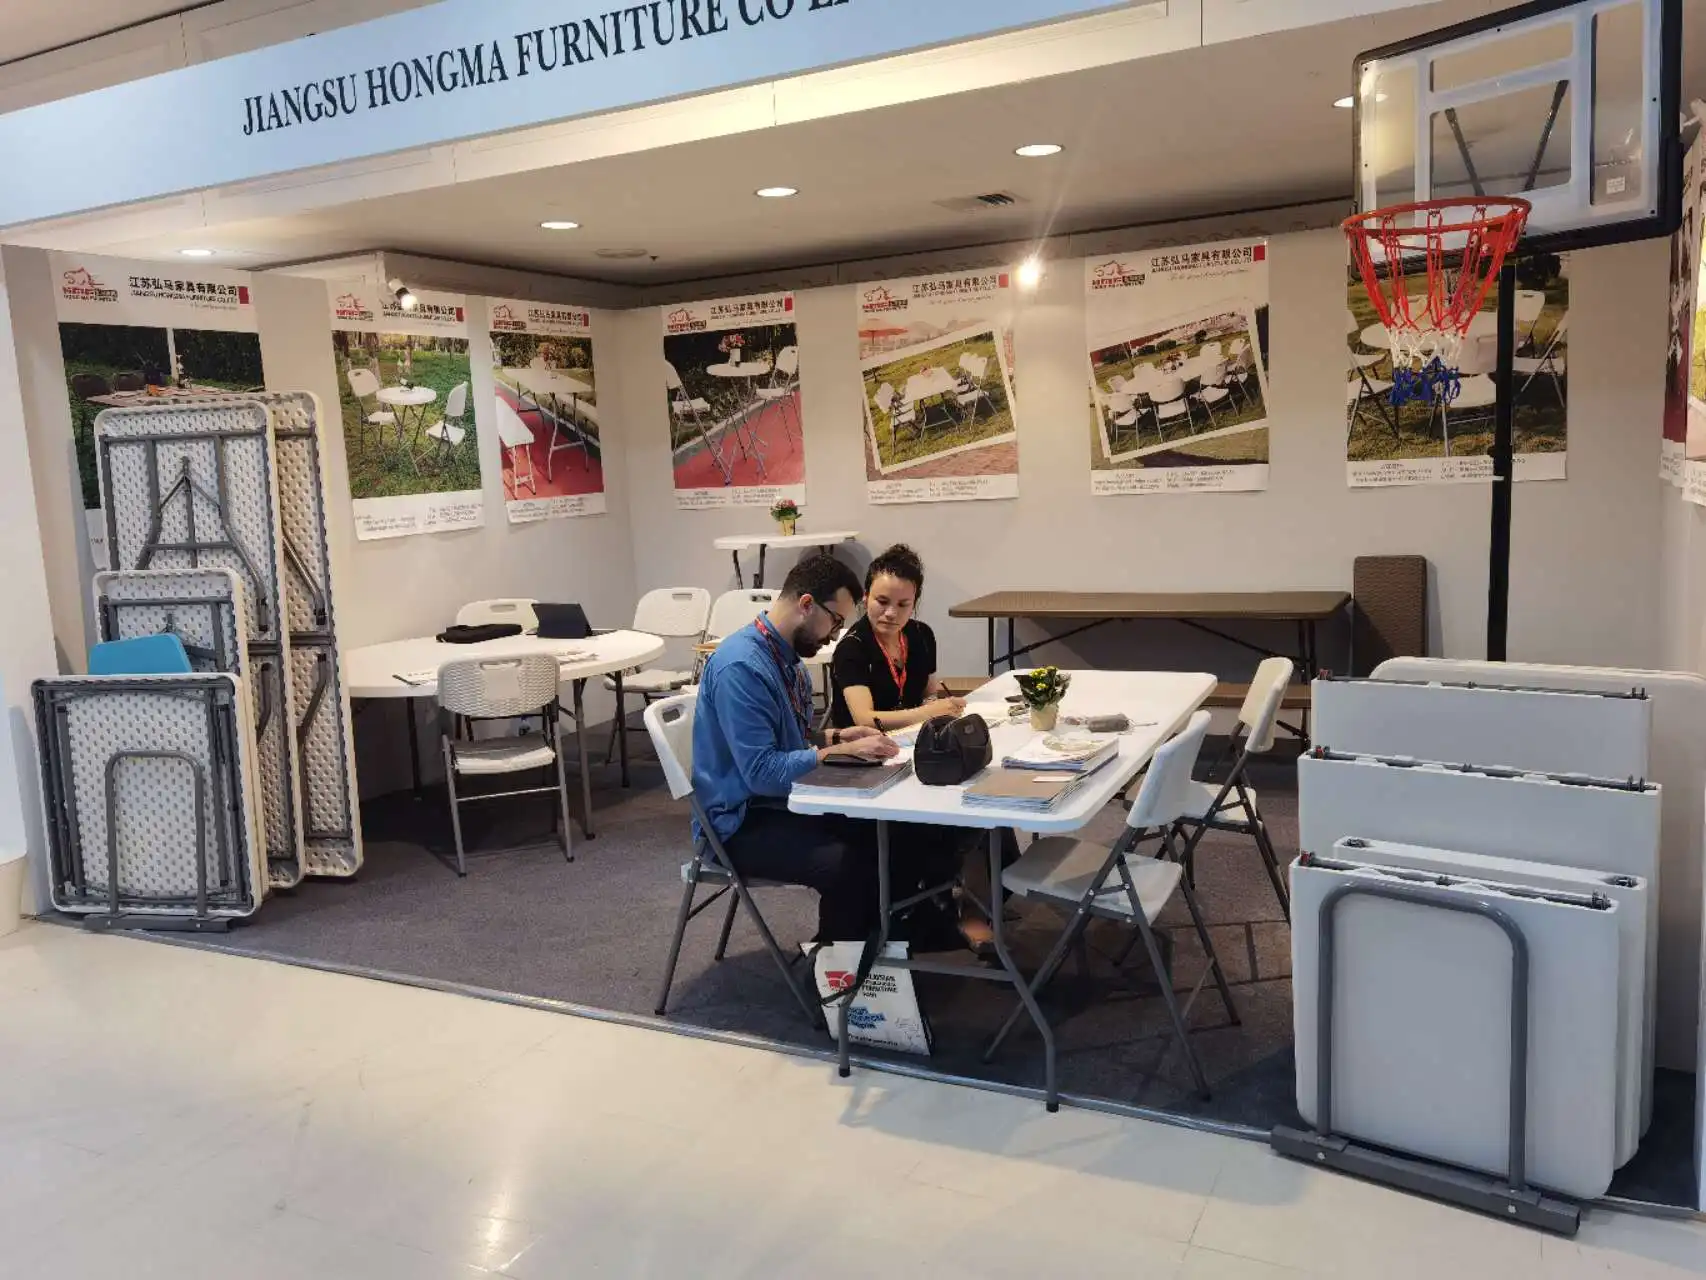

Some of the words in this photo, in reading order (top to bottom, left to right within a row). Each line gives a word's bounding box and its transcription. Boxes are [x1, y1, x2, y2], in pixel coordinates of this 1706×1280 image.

[243, 73, 357, 136] JIANGSU
[364, 39, 509, 110] HONGMA
[513, 0, 728, 78] FURNITURE
[1151, 246, 1252, 267] 江苏弘马家具有限公司
[129, 276, 238, 296] 江苏弘马家具有限公司
